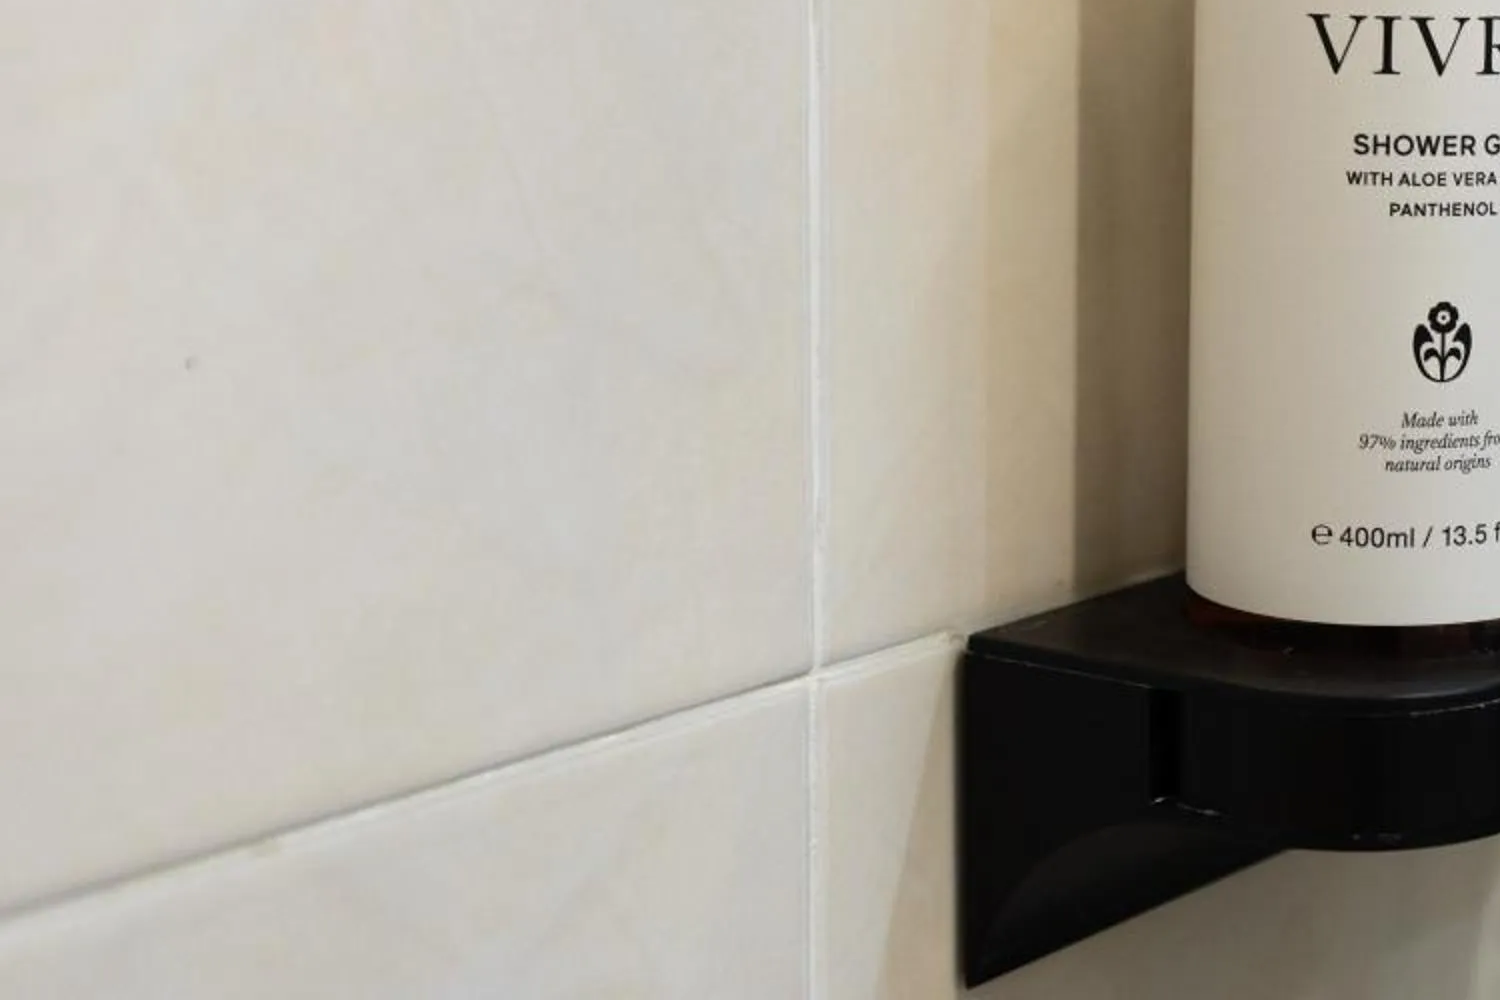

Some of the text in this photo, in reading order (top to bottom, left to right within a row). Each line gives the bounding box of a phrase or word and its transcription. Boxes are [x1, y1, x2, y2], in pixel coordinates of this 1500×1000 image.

[1353, 133, 1477, 157] SHOWER
[1346, 171, 1393, 187] WITH
[1398, 172, 1447, 187] ALOE
[1453, 171, 1497, 187] VERA
[1389, 201, 1498, 217] PANTHENOL
[1401, 409, 1479, 429] Made with
[1358, 433, 1396, 450] 97%
[1400, 432, 1480, 455] ingredients
[1385, 455, 1492, 475] natural origins
[1339, 527, 1415, 549] 400ml
[1422, 527, 1434, 548] /
[1441, 523, 1488, 547] 13.5
